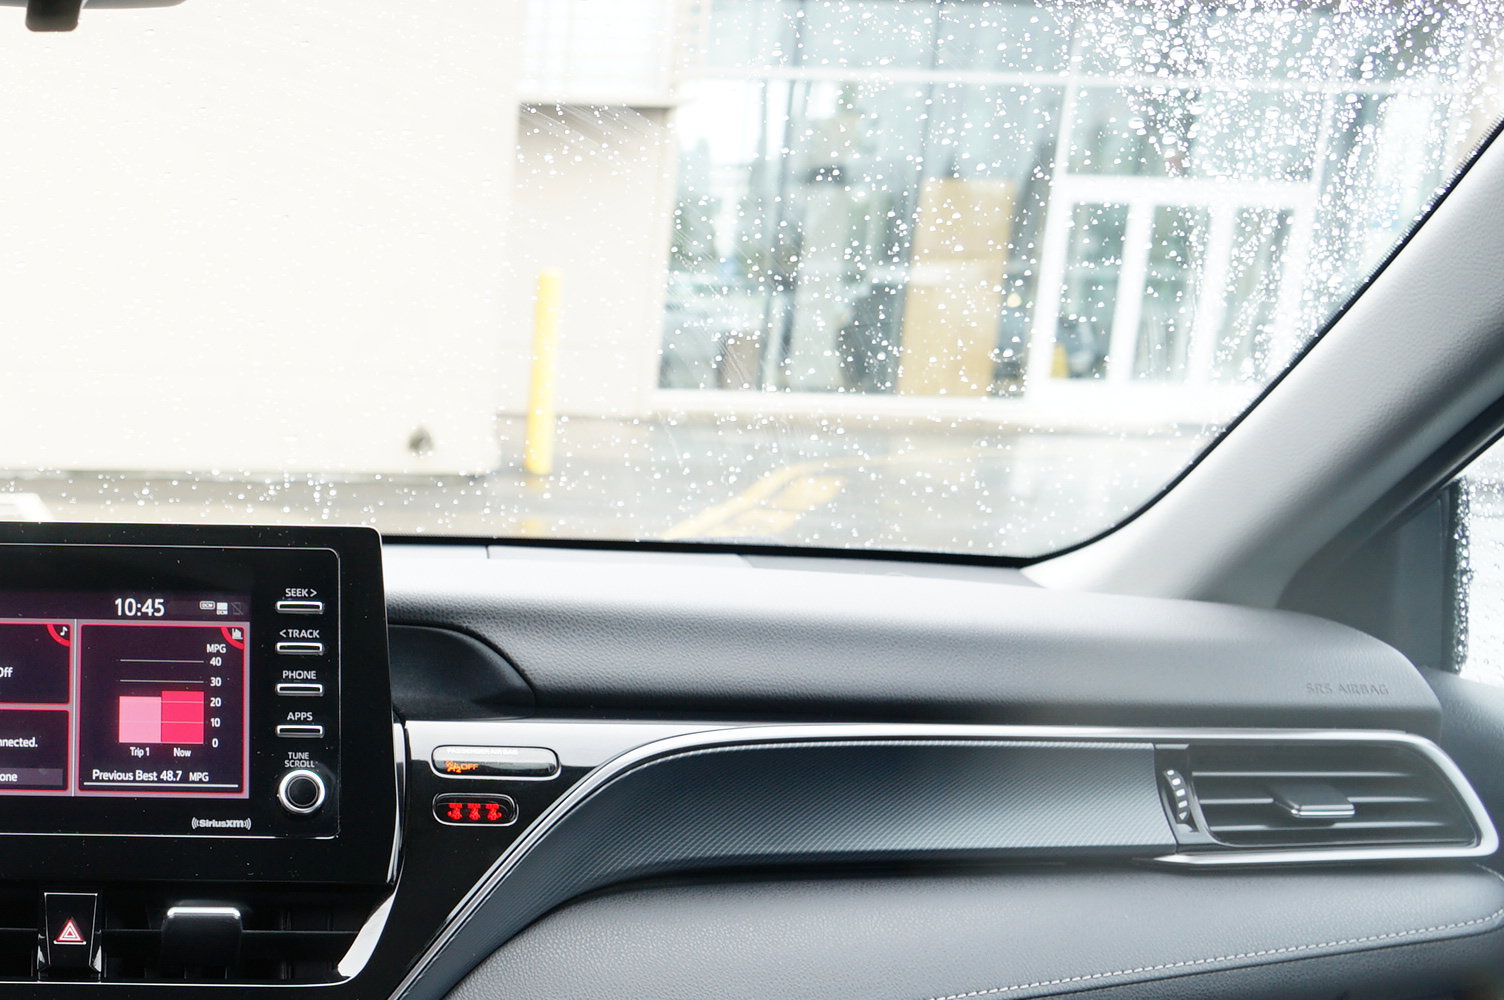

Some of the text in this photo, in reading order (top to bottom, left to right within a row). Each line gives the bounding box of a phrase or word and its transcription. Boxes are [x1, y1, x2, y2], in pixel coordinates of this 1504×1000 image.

[285, 589, 309, 597] SEEK
[114, 598, 165, 616] 10:45
[288, 630, 320, 639] TRACK
[206, 644, 226, 654] MPG
[210, 657, 222, 667] 40
[283, 671, 317, 679] PHONE
[210, 677, 222, 687] 30
[210, 697, 222, 707] 20
[287, 712, 313, 721] APPS
[210, 718, 221, 728] 10
[212, 738, 219, 747] 0
[130, 747, 150, 758] Trip 1
[173, 748, 191, 758] Now
[287, 752, 310, 760] TUNE
[284, 760, 315, 768] SCROLL
[92, 769, 210, 782] Previous Best 48.7 MPG
